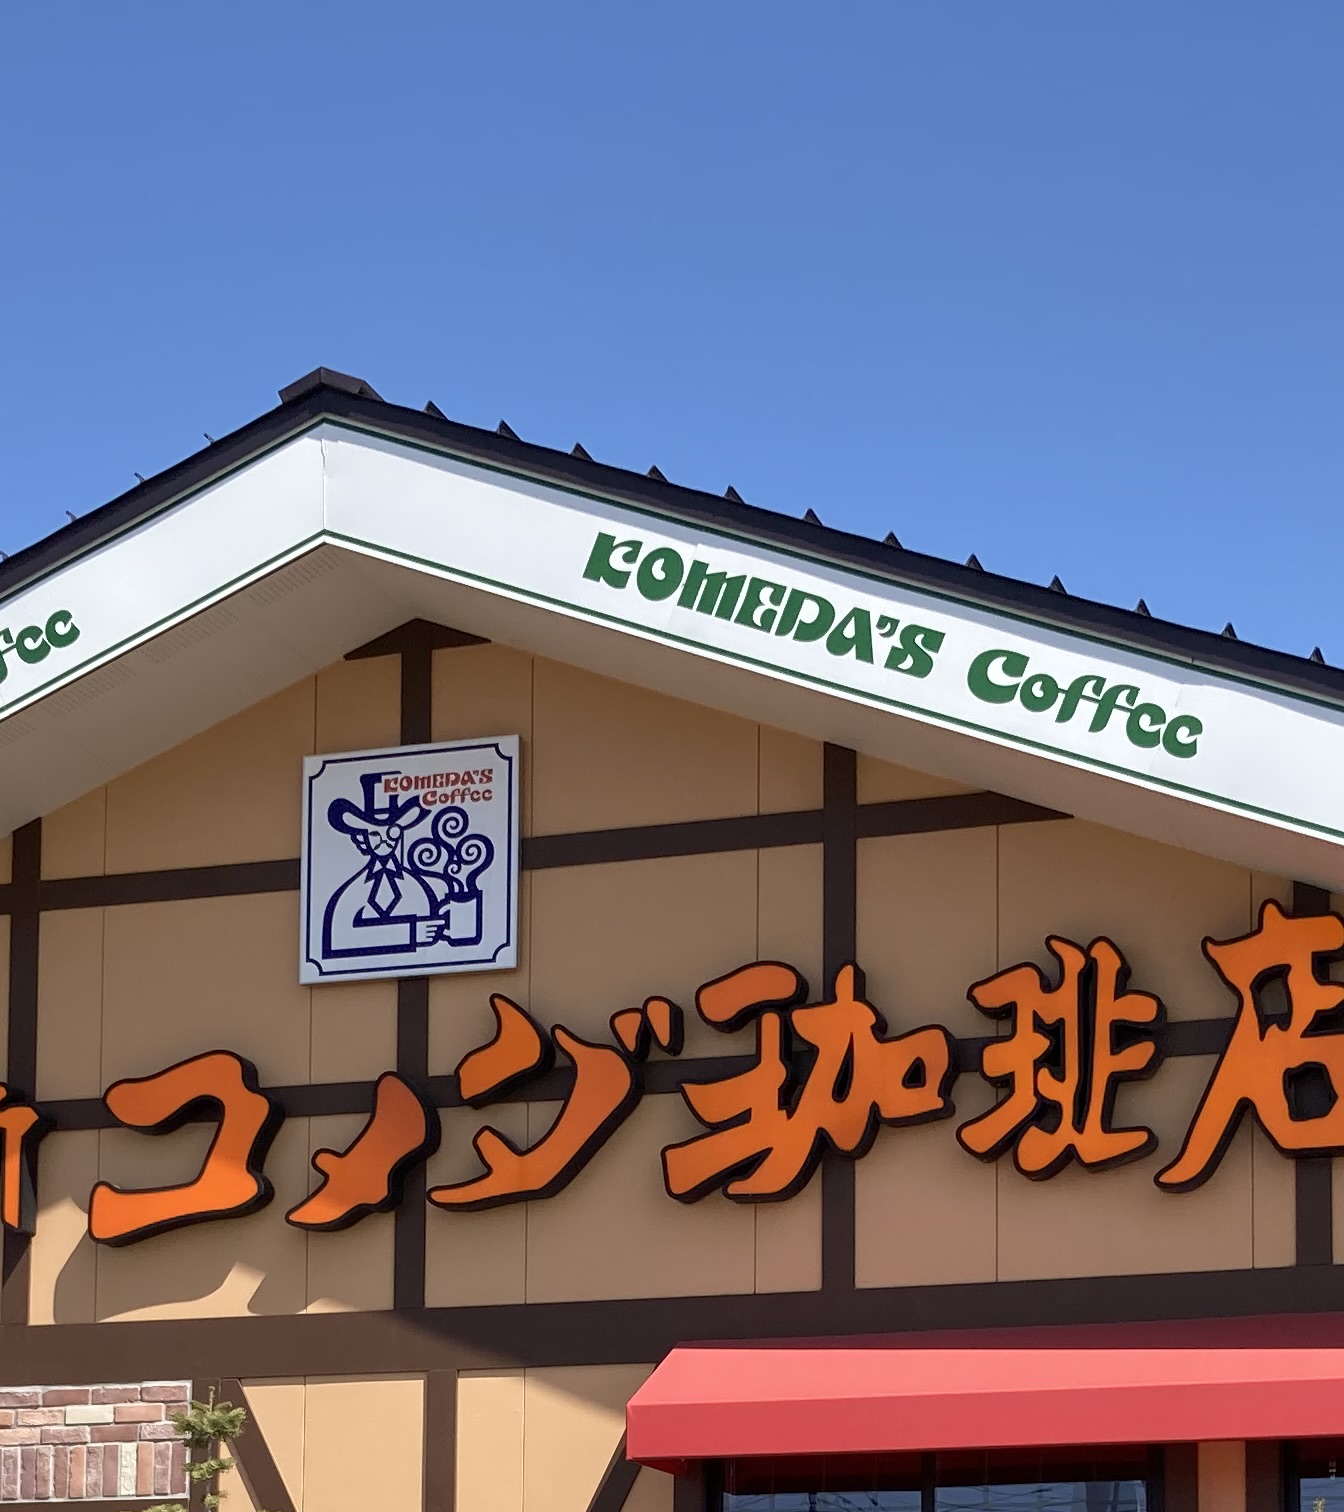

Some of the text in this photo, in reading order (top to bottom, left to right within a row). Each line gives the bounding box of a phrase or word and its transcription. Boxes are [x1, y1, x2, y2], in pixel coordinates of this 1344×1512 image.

[582, 532, 1203, 758] KOMEDA'S Coffee
[383, 768, 494, 793] KOMEDA'S
[422, 787, 493, 806] Coffee
